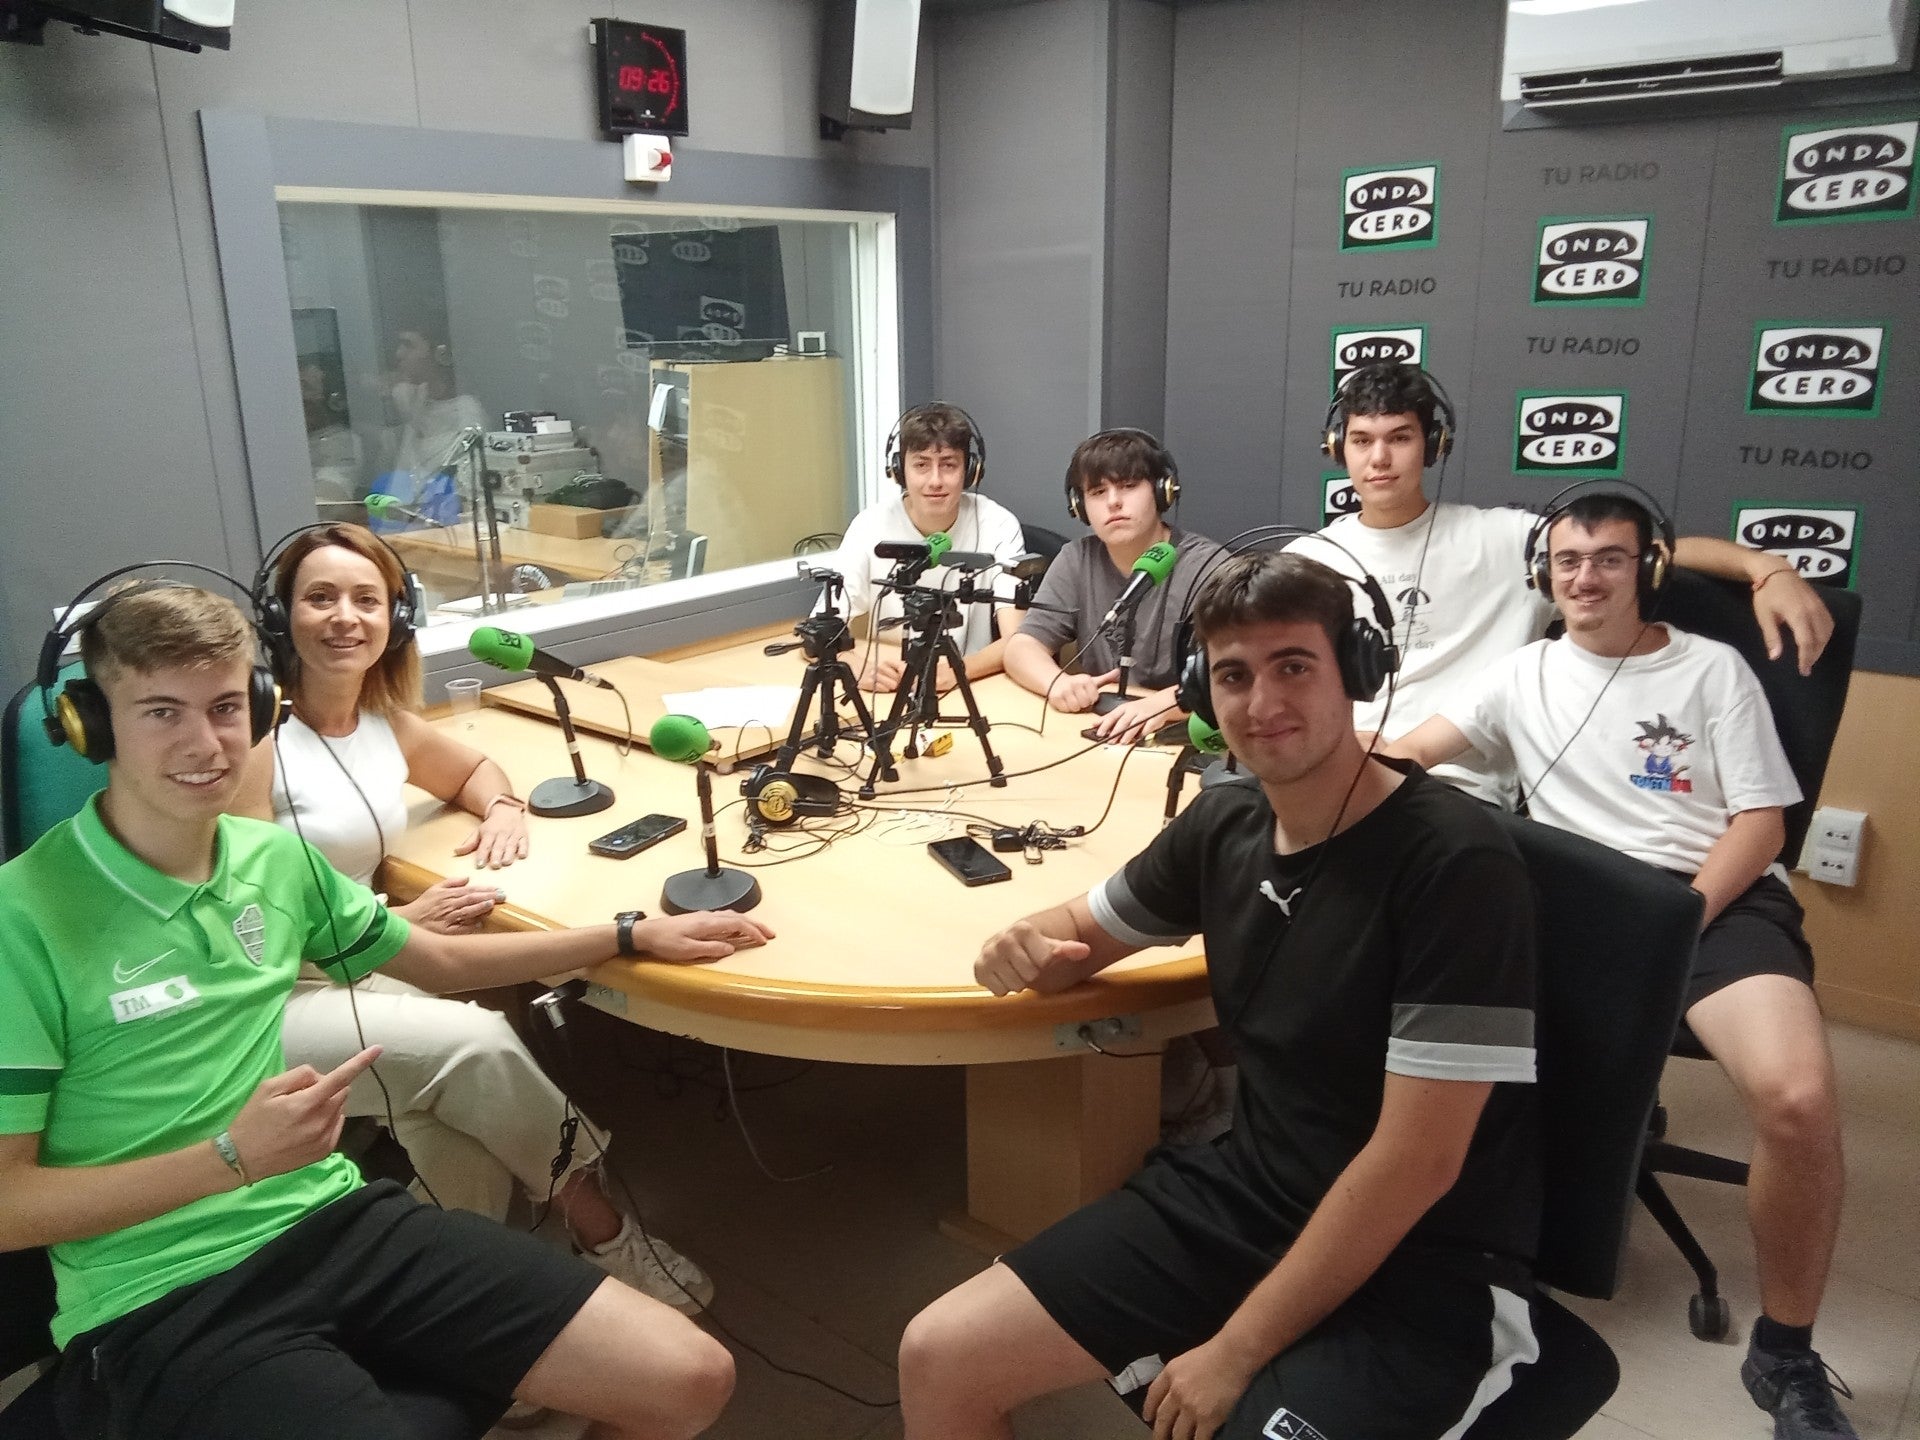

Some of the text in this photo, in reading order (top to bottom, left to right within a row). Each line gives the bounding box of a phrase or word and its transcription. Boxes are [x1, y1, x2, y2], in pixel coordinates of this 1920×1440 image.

[1802, 142, 1896, 168] ONDA
[1543, 161, 1661, 186] TU RADIO
[1355, 183, 1422, 205] ONDA
[1804, 178, 1892, 203] CERO
[1359, 213, 1420, 234] CERO
[1553, 236, 1630, 257] ONDA
[1767, 254, 1907, 279] TU RADIO
[1338, 277, 1437, 298] TU RADIO
[1555, 268, 1626, 287] CERO
[1345, 344, 1409, 361] ONDA
[1527, 336, 1641, 356] TU RADIO
[1773, 344, 1862, 362] ONDA
[1774, 376, 1858, 396] CERO
[1532, 411, 1606, 428] ONDA
[1534, 440, 1604, 457] CERO
[1739, 446, 1873, 471] TU RADIO
[1335, 490, 1362, 506] ON
[1751, 523, 1836, 541] ONDA
[1796, 555, 1832, 573] RO
[118, 994, 151, 1017] TM
